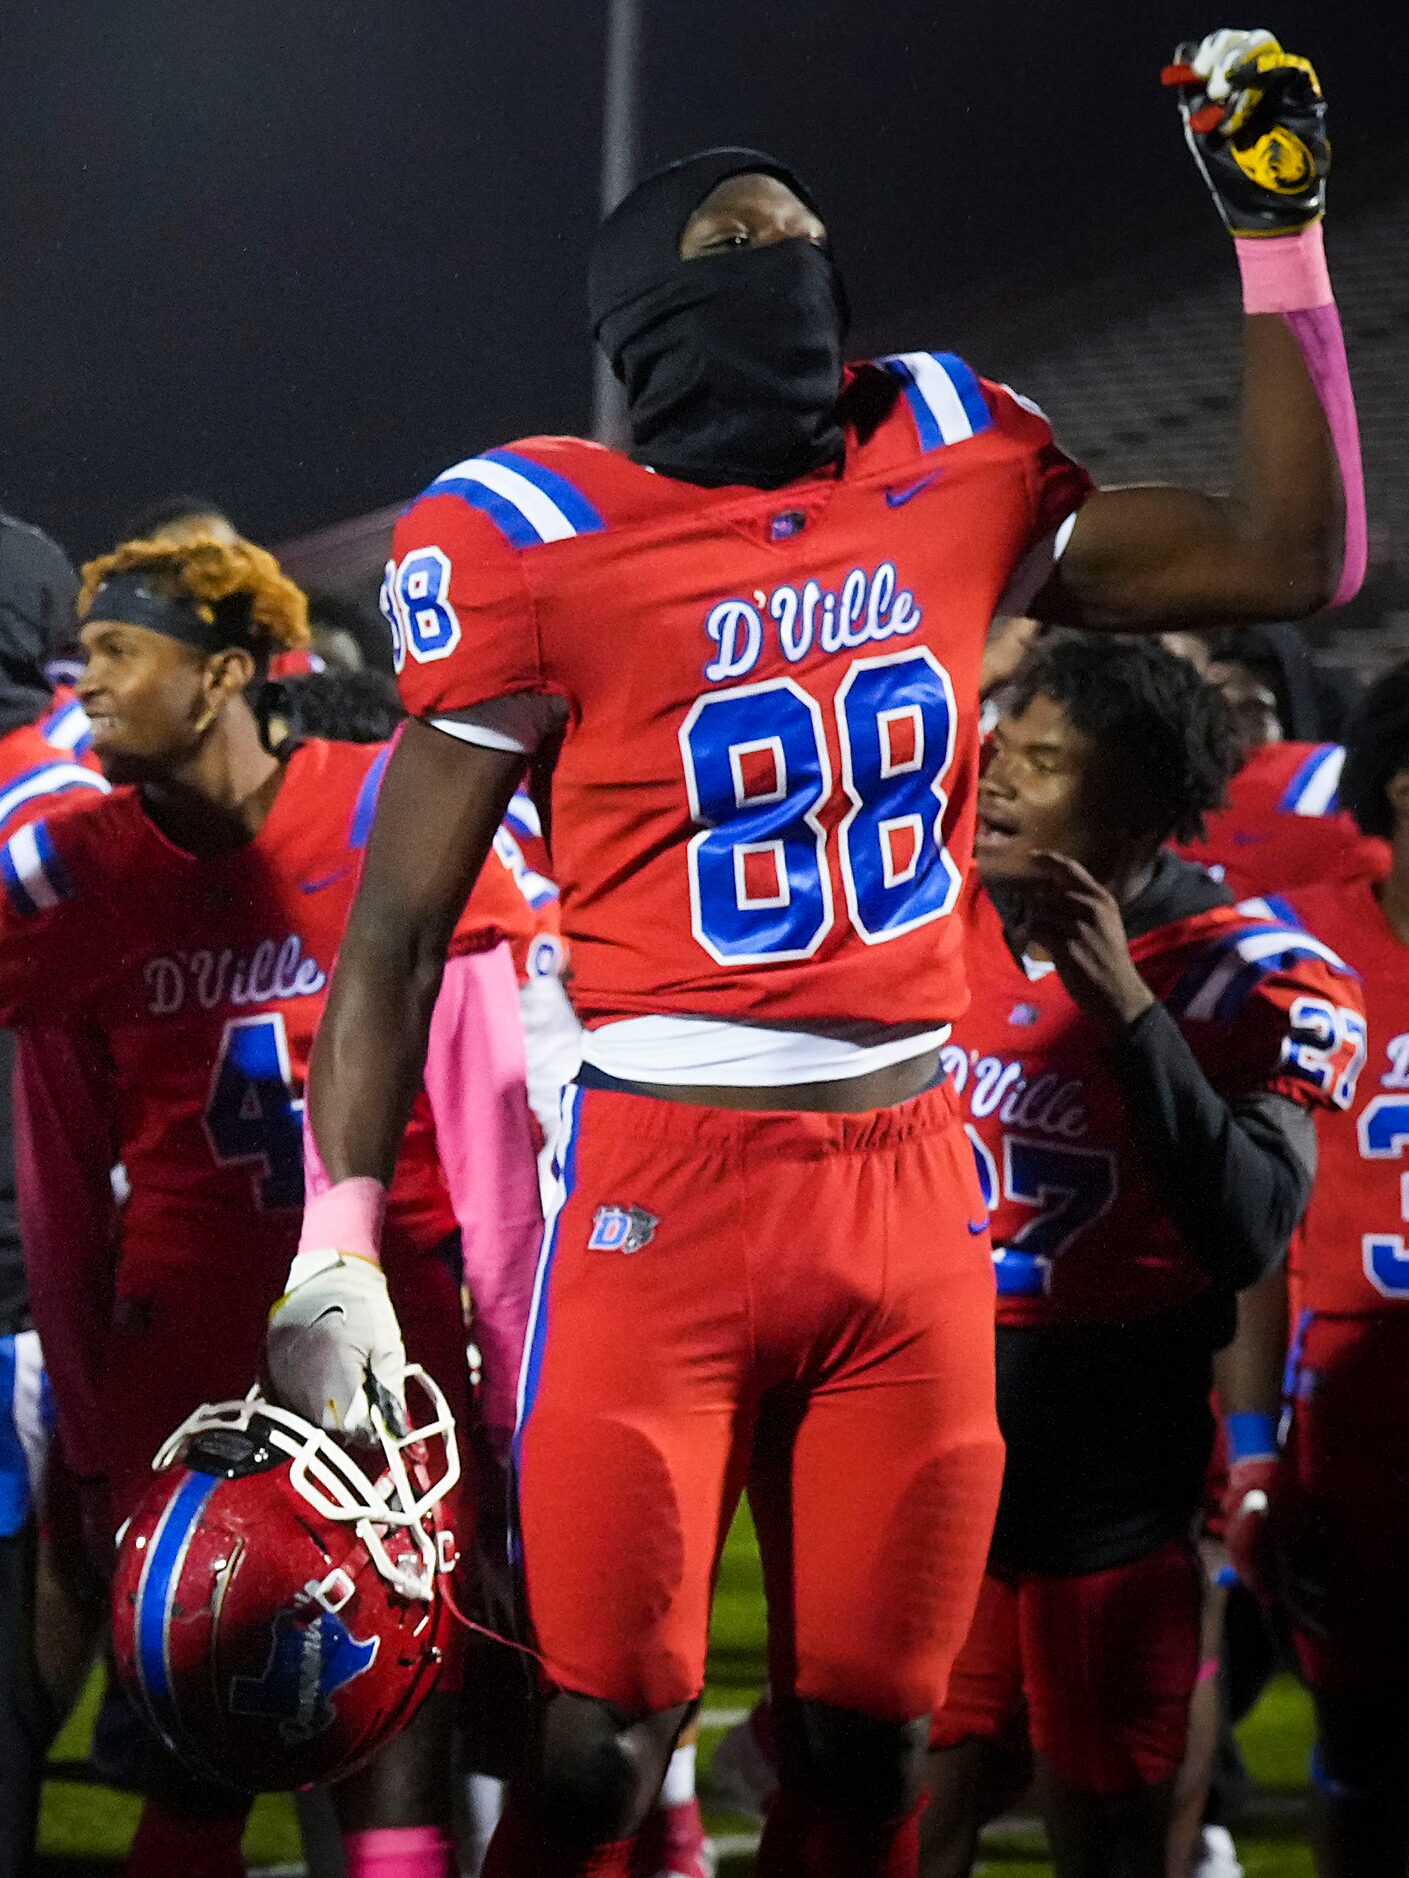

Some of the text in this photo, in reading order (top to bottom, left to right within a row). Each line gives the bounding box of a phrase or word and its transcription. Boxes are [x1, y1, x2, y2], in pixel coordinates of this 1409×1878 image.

[704, 562, 924, 684] D'Ville
[678, 645, 963, 966] 88
[144, 932, 327, 1014] D'Ville
[202, 1011, 306, 1212] 4
[1280, 996, 1367, 1112] 27
[963, 1121, 1119, 1297] 7
